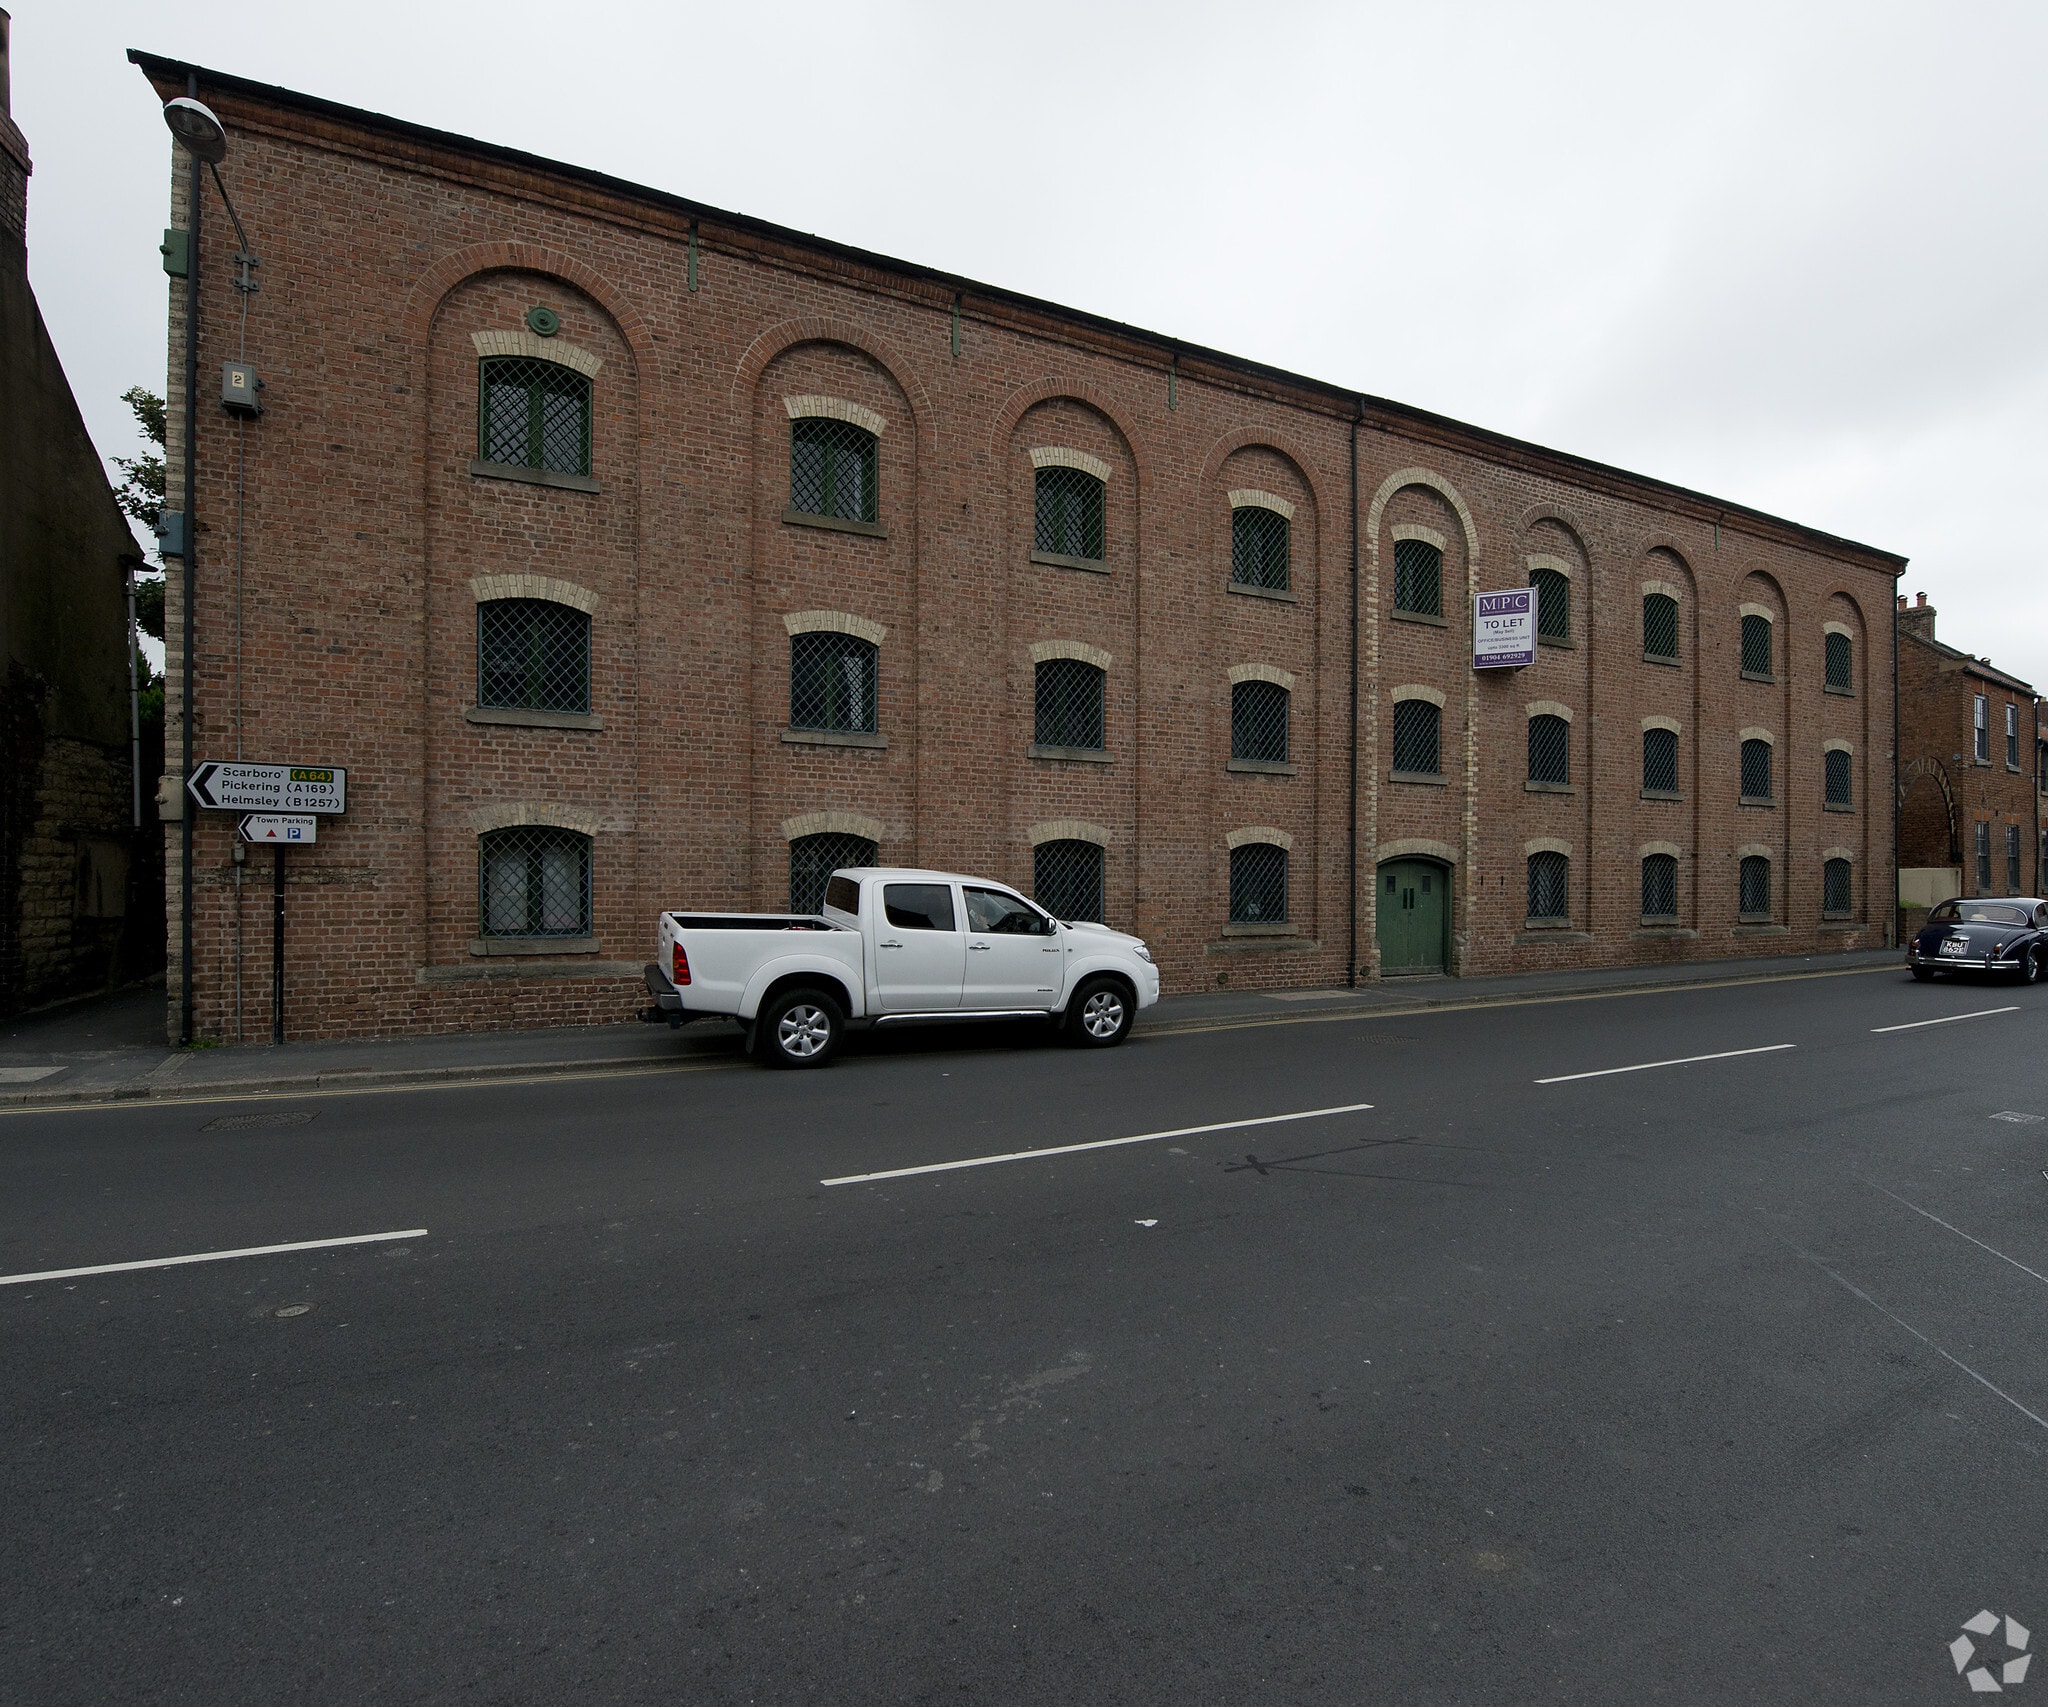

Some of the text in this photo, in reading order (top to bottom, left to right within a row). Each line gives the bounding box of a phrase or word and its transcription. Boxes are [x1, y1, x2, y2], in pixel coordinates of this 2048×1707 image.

[234, 375, 242, 384] 2
[1484, 618, 1524, 629] TO LET
[222, 780, 281, 793] Pickering
[221, 794, 280, 807] Helmsley
[256, 816, 314, 826] Town Parking
[289, 828, 300, 838] P
